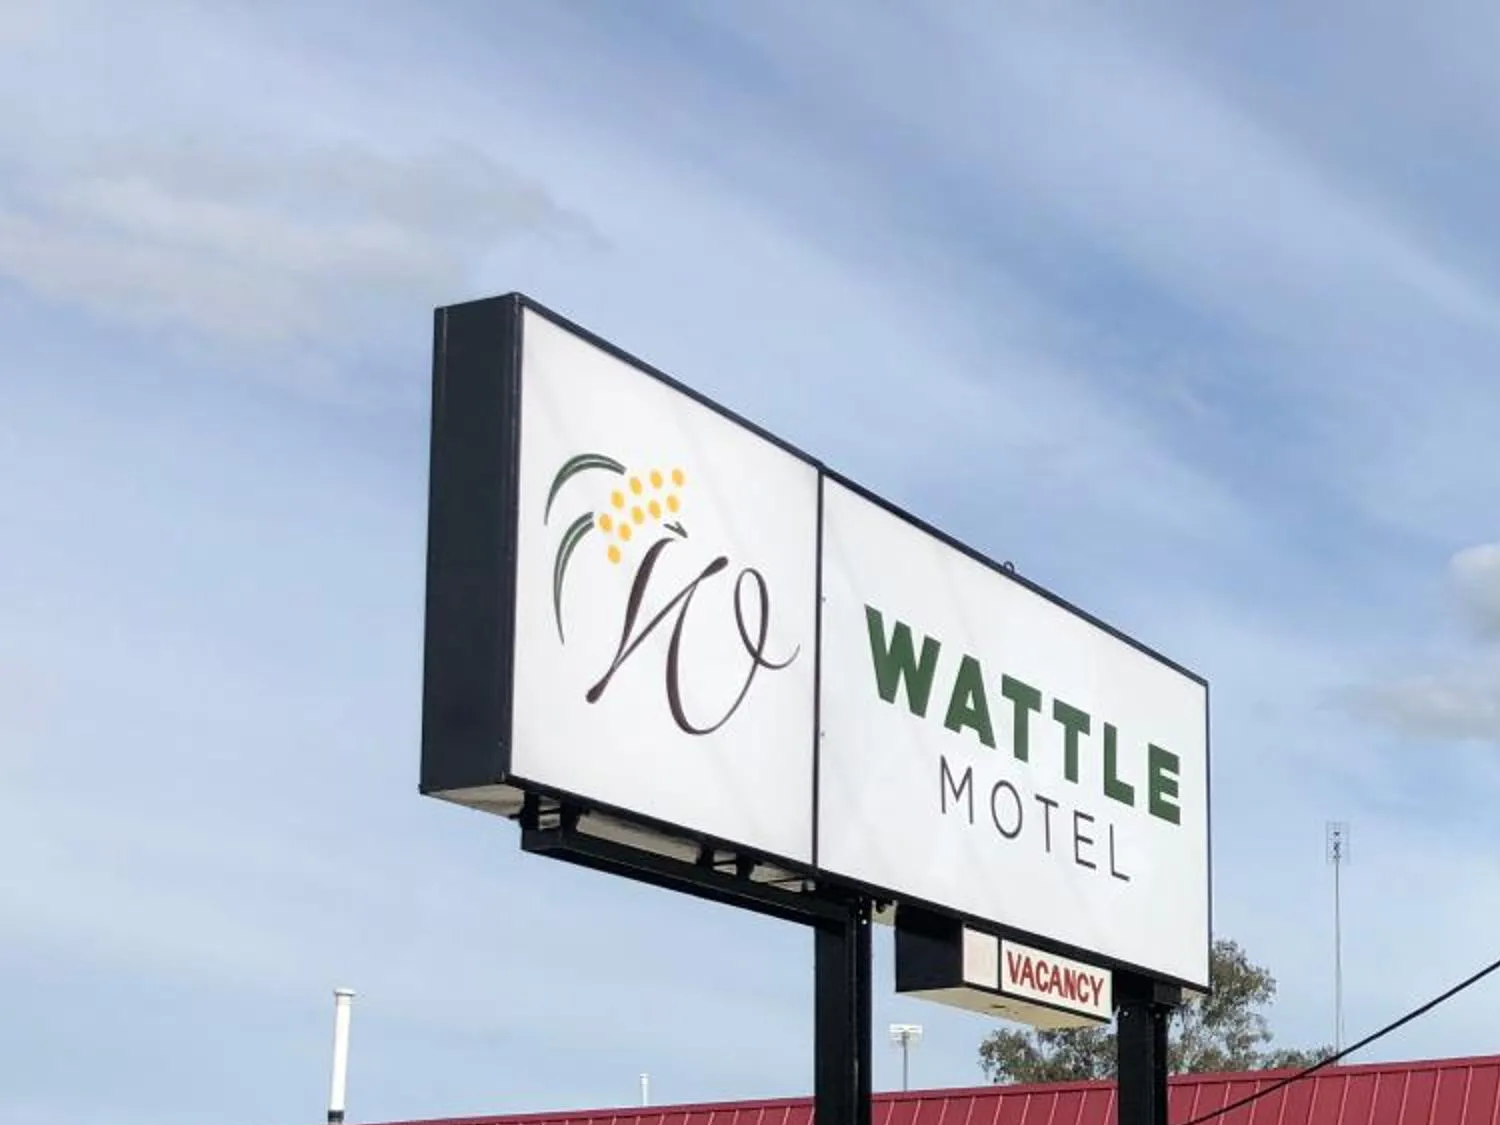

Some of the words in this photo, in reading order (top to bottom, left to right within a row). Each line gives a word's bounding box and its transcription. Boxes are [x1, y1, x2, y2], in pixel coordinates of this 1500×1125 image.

[864, 603, 1181, 826] WATTLE
[940, 754, 1131, 882] MOTEL
[1006, 950, 1105, 1006] VACANCY
